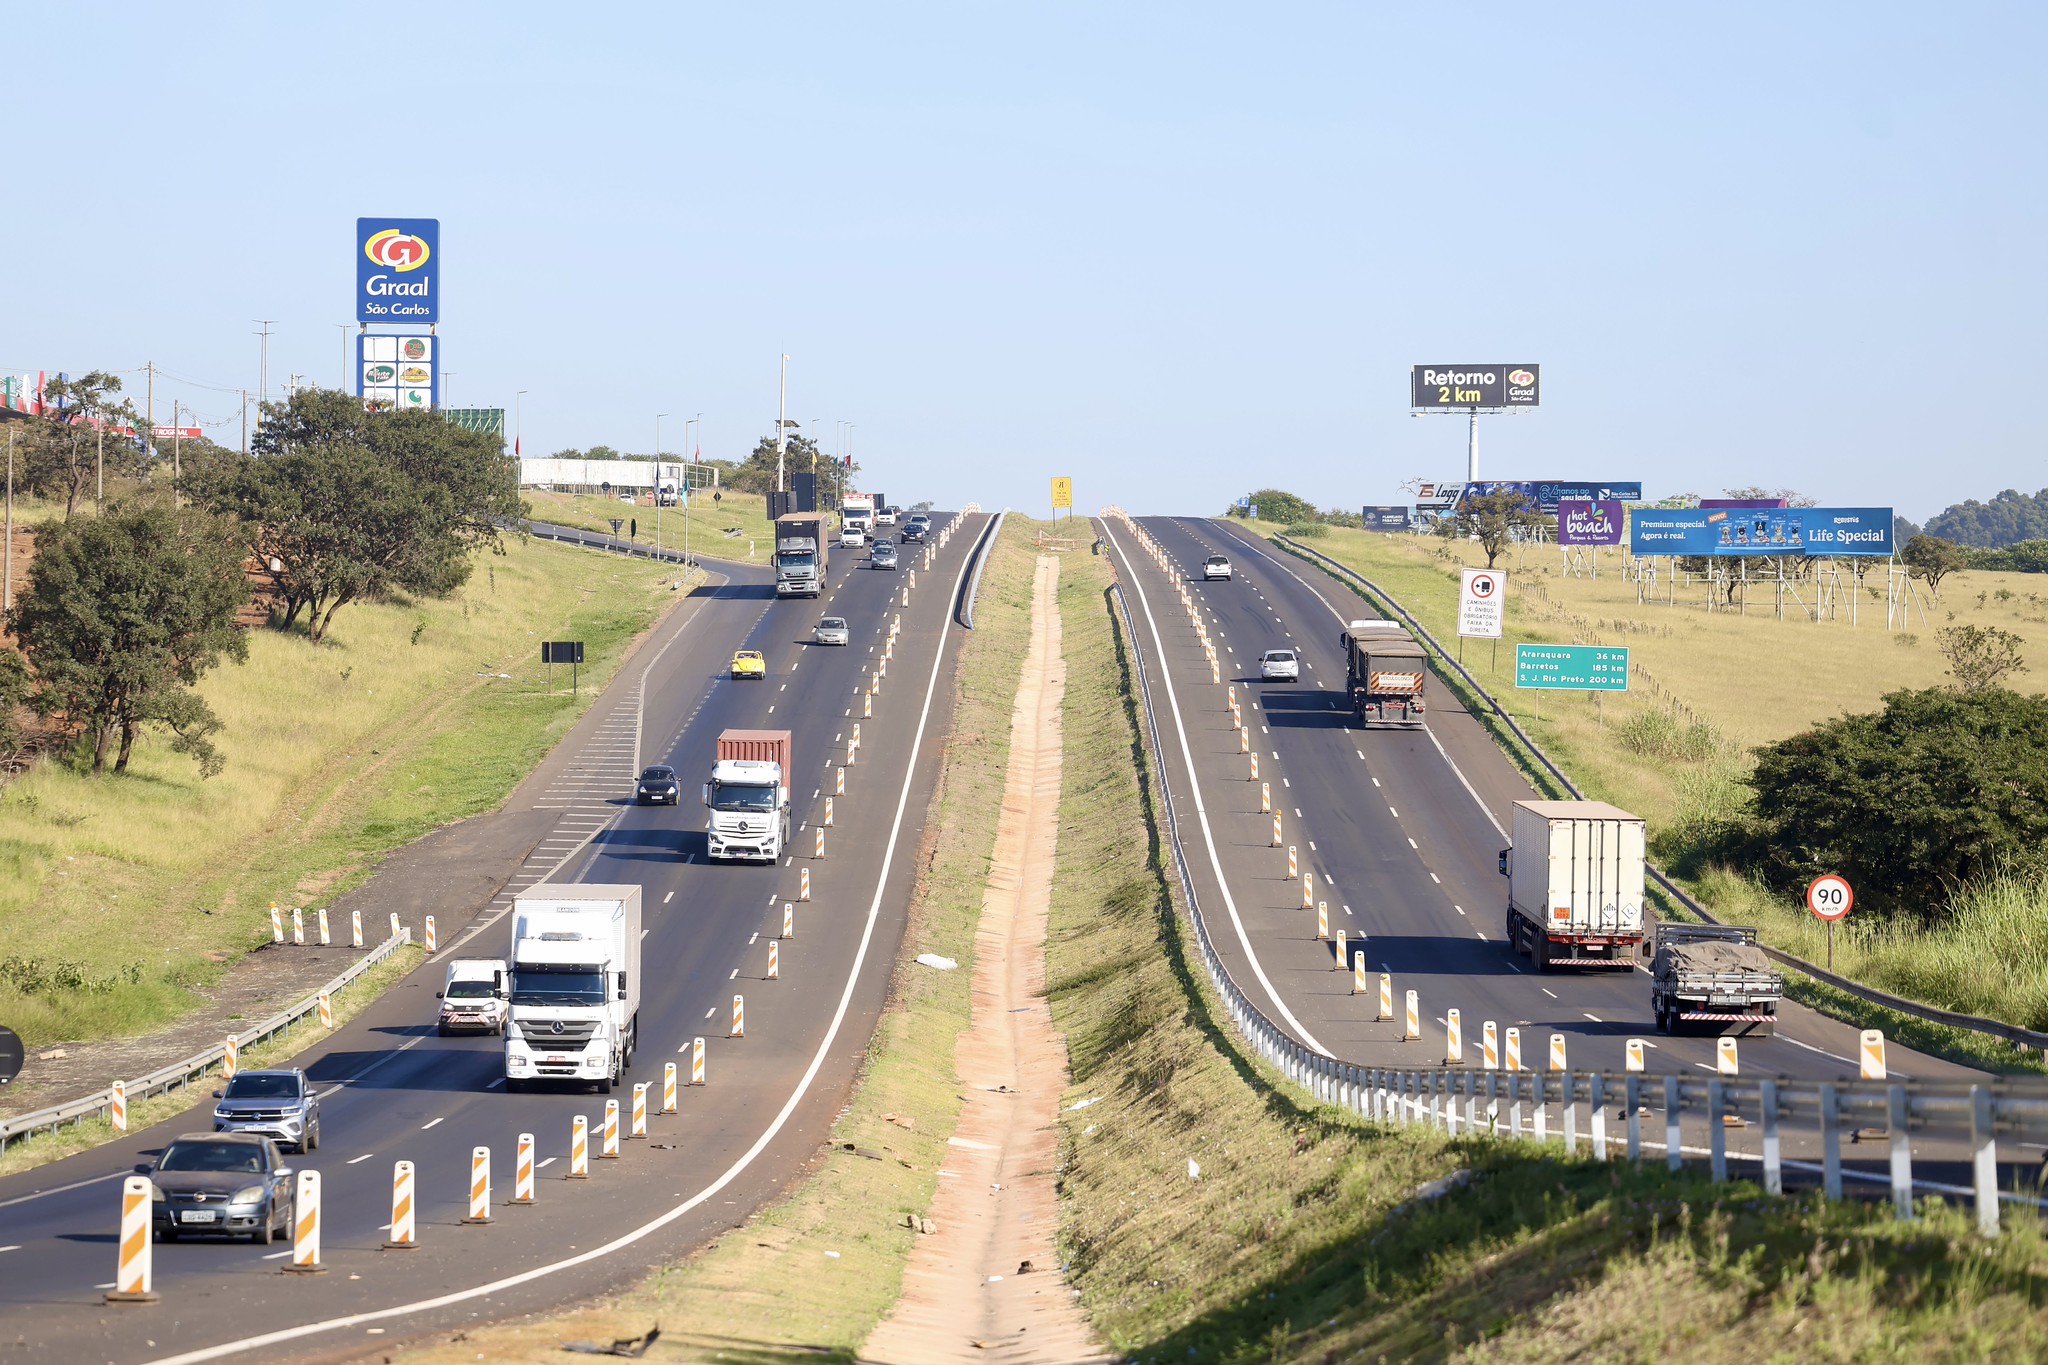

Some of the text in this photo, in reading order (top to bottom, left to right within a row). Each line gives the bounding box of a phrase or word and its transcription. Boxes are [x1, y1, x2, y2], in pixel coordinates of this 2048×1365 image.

[366, 274, 428, 296] Graal
[366, 302, 430, 314] São Carlos
[1424, 370, 1496, 385] Retorno
[1439, 386, 1481, 402] 2 km
[1509, 387, 1534, 396] Graal
[1435, 484, 1459, 503] Logg
[1571, 510, 1588, 521] hot
[1709, 512, 1727, 522] NOVO!
[1567, 515, 1613, 533] beach
[1675, 520, 1706, 529] especial.
[1641, 532, 1662, 540] Agora
[1809, 529, 1884, 544] Life Special
[1521, 650, 1571, 659] Araraquara
[1818, 888, 1842, 905] 90
